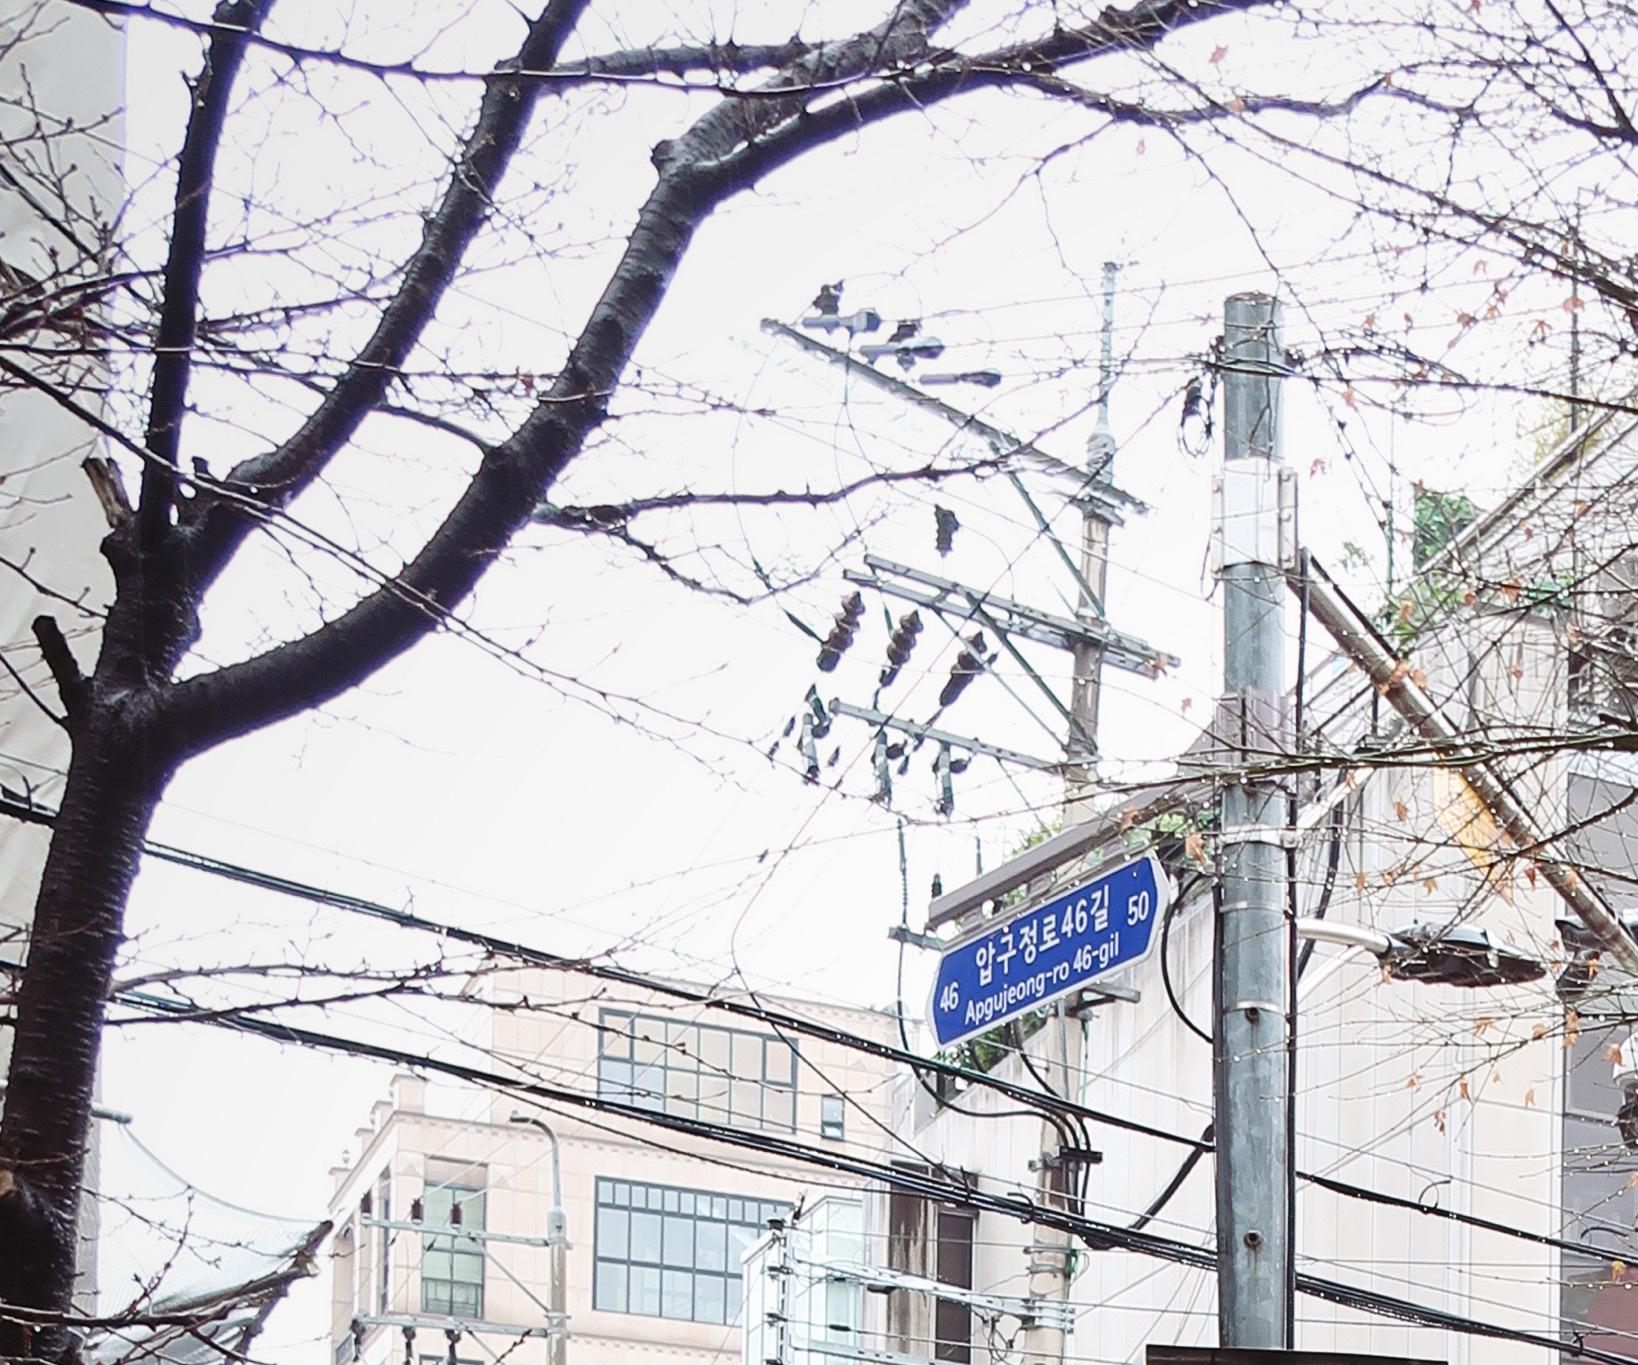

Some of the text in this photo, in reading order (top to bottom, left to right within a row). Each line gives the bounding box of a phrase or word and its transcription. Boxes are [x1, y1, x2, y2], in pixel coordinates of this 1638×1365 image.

[975, 884, 1110, 986] 압구정로46길
[1127, 890, 1149, 926] 50
[939, 981, 960, 1013] 46
[964, 931, 1120, 1026] Apgujeong-ro 46-gil
